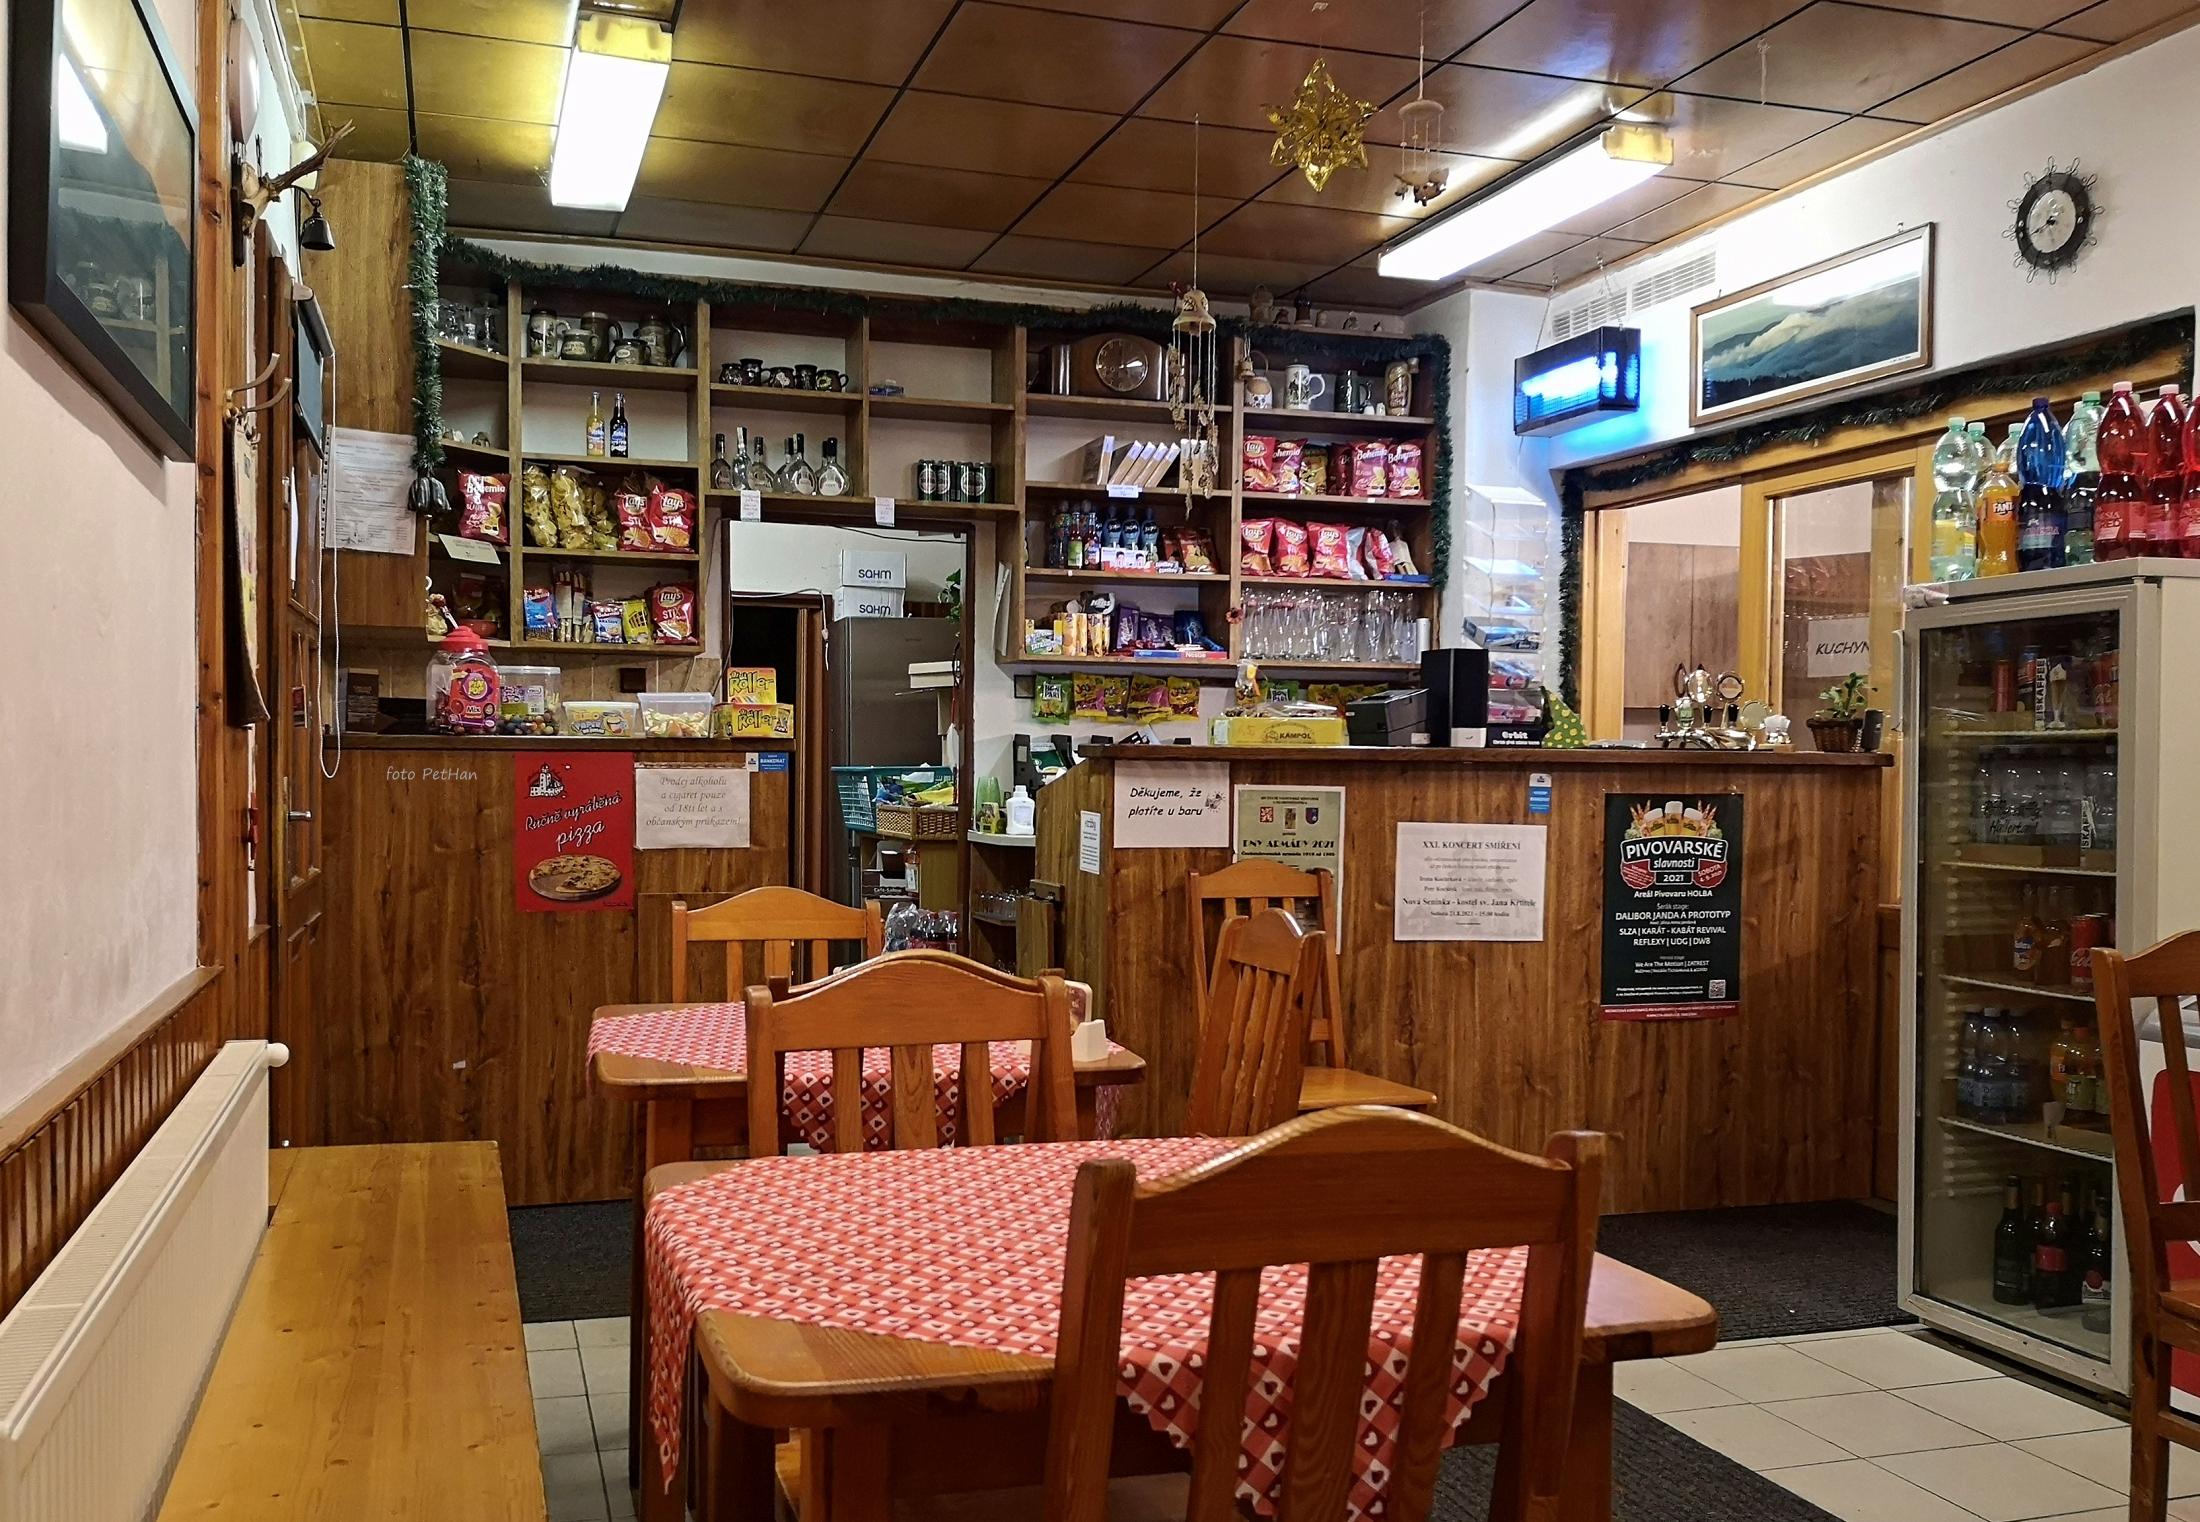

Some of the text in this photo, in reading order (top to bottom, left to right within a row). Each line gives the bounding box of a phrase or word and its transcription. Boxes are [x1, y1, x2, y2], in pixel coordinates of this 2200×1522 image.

[1273, 449, 1300, 458] ohemia
[729, 671, 774, 696] Roller
[738, 710, 777, 731] Roller
[1502, 731, 1527, 739] Orbit
[660, 775, 688, 788] Prodej
[1129, 787, 1202, 800] Děkujeme, že
[525, 791, 622, 830] Ručně vyráběná
[664, 804, 675, 813] od
[697, 804, 708, 813] let
[1128, 805, 1163, 818] platíte
[1178, 806, 1203, 815] baru
[556, 821, 605, 852] pizza
[1442, 841, 1482, 850] KONCERT
[1485, 840, 1521, 850] SMÍŘENÍ
[1625, 840, 1723, 858] PIVOVARSKÉ
[1653, 857, 1695, 869] slavnosti
[1663, 874, 1684, 882] 2021
[1634, 890, 1653, 898] Areál
[1654, 890, 1686, 898] Pivovaru
[1616, 910, 1731, 921] DALIBOR JANDA A PROTOTYP
[1641, 926, 1665, 935] KARÁT
[1696, 926, 1726, 934] REVIVAL
[1633, 938, 1665, 946] REFLEXY
[1671, 938, 1688, 946] UDG
